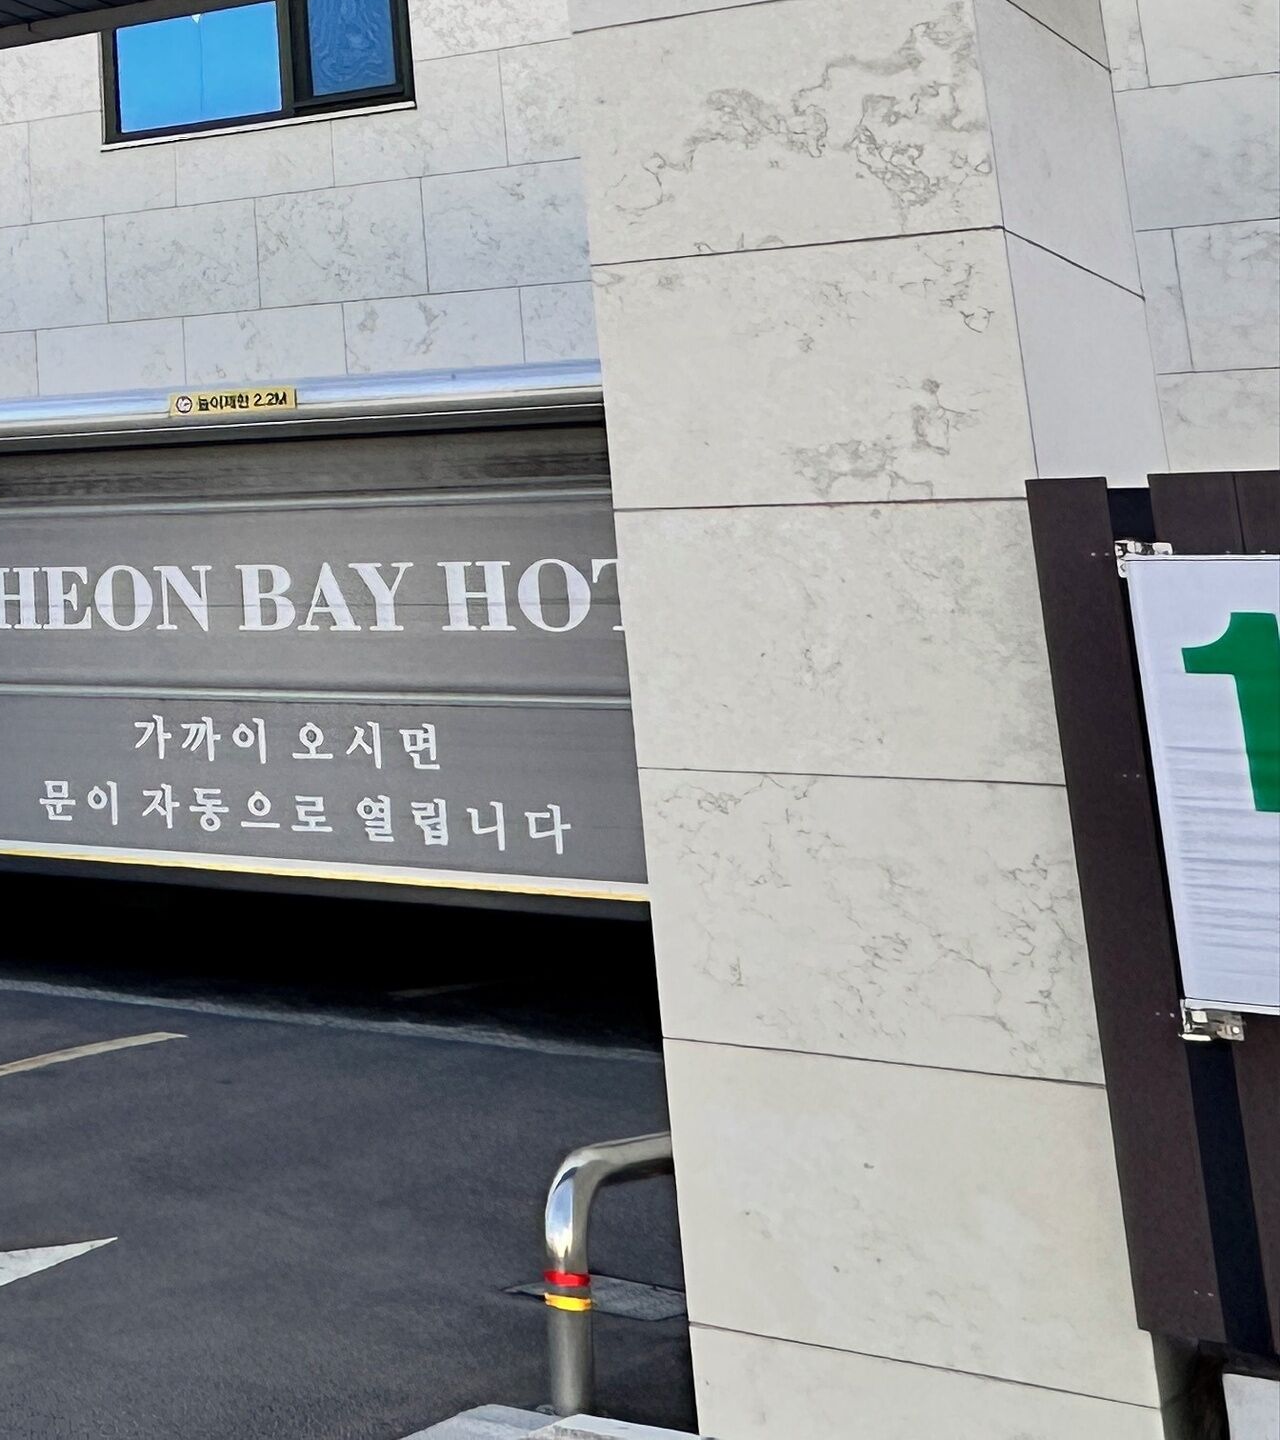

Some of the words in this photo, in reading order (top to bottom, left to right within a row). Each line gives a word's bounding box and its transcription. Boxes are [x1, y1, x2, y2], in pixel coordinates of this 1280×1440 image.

[235, 561, 415, 632] BAY
[134, 714, 267, 764] 가까이
[292, 721, 441, 770] 오시면
[1181, 611, 1280, 813] 1
[39, 780, 119, 826] 문이
[142, 783, 333, 833] 자동으로
[356, 794, 572, 855] 열립니다
